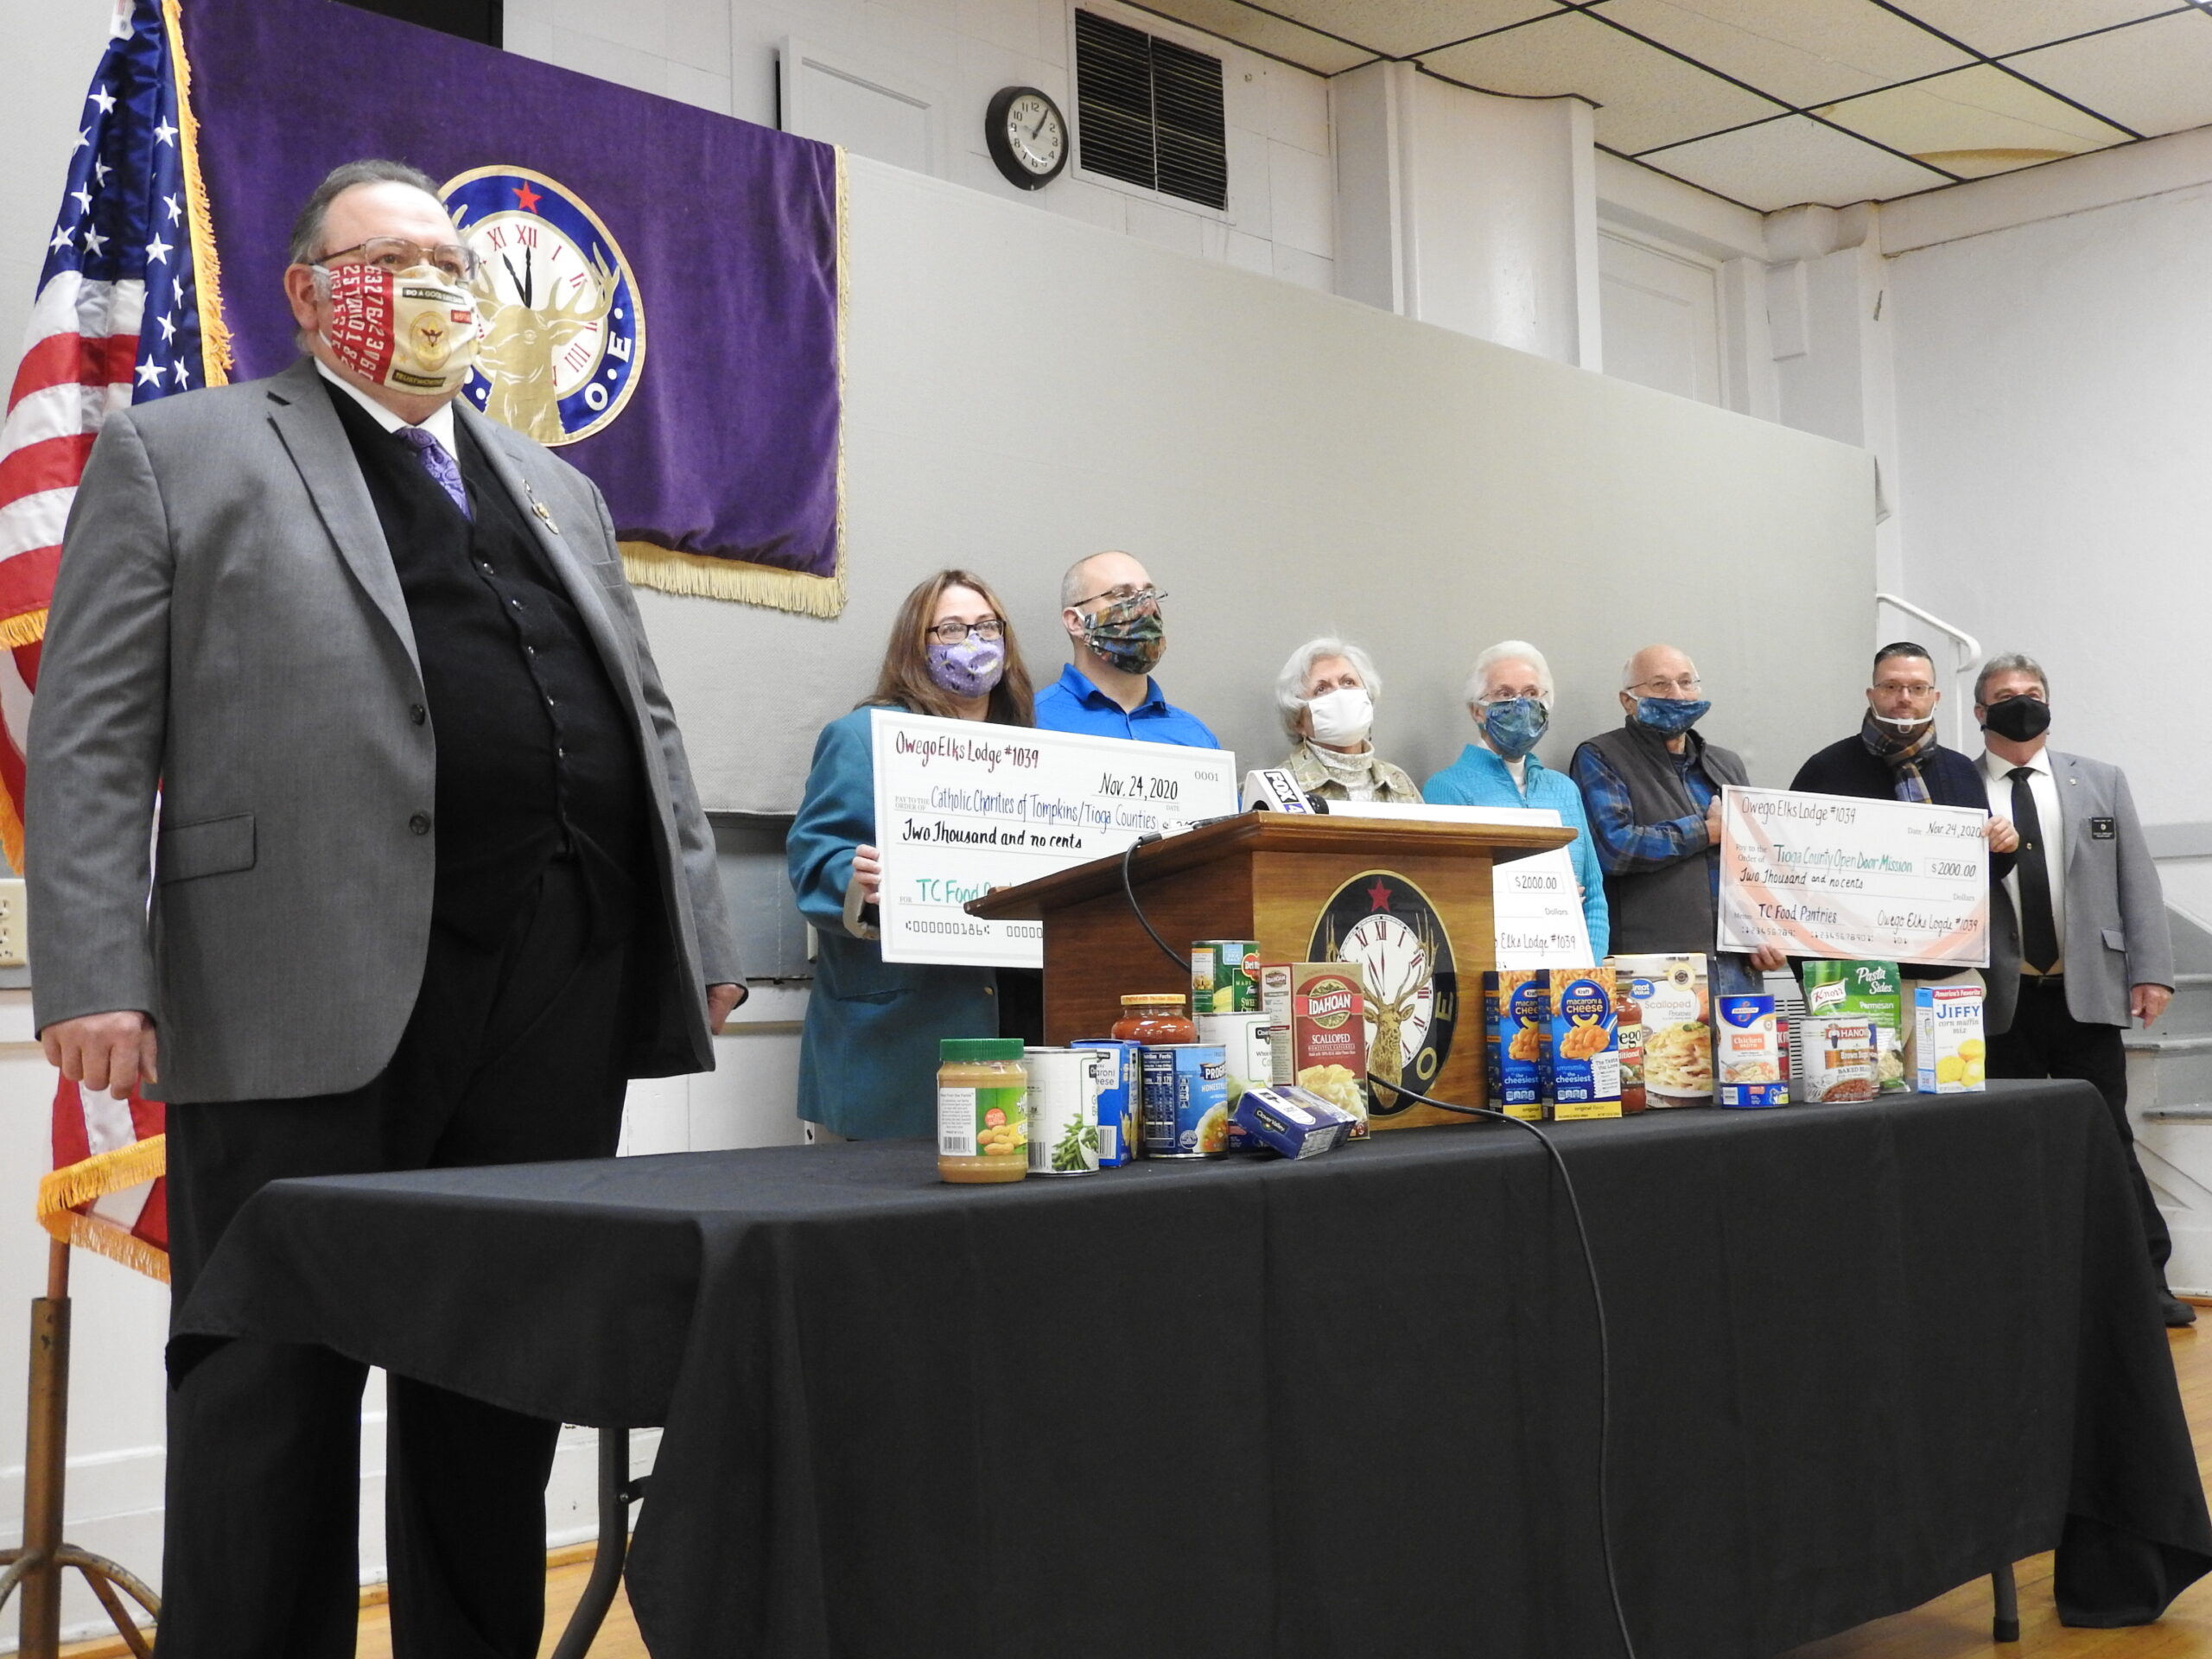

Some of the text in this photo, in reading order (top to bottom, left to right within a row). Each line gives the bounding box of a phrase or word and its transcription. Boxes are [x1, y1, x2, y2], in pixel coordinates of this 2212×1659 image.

[1022, 102, 1028, 112] 11
[1031, 102, 1039, 112] 12
[1014, 110, 1022, 122] 10
[1050, 123, 1055, 132] 2
[1014, 138, 1020, 148] 8
[1052, 137, 1058, 147] 3
[1048, 150, 1054, 159] 4
[486, 226, 507, 251] XI
[516, 224, 537, 248] XII
[551, 245, 562, 260] I
[896, 731, 1039, 773] Owego Elks Lodge #1039
[1194, 771, 1219, 781] 0001
[1099, 772, 1126, 797] Nov.
[1265, 772, 1300, 803] FOX
[931, 785, 972, 811] Catholic
[973, 789, 1014, 816] Charities
[1017, 793, 1027, 822] of
[1116, 804, 1156, 830] Counties
[1742, 796, 1856, 826] Owego Elks Lodge #1039
[902, 817, 1082, 849] Two Thousand and no cents
[1736, 843, 1746, 853] Pay
[1757, 844, 1767, 853] the
[1738, 854, 1766, 863] Order of
[1773, 844, 1913, 875] Tioga County Open Door Mission
[1739, 867, 1864, 889] Two Thousand and no cents
[916, 879, 941, 902] TC
[946, 880, 979, 904] Food
[1545, 907, 1568, 916] Dollars
[1758, 903, 1837, 924] TC Food Pantries
[1375, 920, 1387, 940] XII
[1878, 910, 1905, 935] Owego
[1906, 912, 1926, 928] Elks
[1955, 918, 1979, 932] #1039
[1355, 928, 1369, 950] XI
[1397, 931, 1406, 948] I
[1501, 932, 1576, 957] Elks Lodge #1039
[1856, 966, 1886, 985] Pasta
[1631, 982, 1649, 992] reat
[1869, 981, 1893, 995] Sides
[1241, 997, 1257, 1007] SWEE
[1815, 988, 1844, 1002] Knorr
[1308, 994, 1351, 1015] IDAHOAN
[1644, 1000, 1691, 1009] Scalloped
[1859, 1001, 1894, 1009] Parmesan
[1936, 1004, 1980, 1019] JIFFY
[1312, 1033, 1351, 1044] SCALLOPED
[1619, 1030, 1641, 1049] ego
[1733, 1036, 1763, 1045] Chicken
[1618, 1049, 1641, 1060] ditional
[1096, 1068, 1116, 1077] aroni
[1205, 1063, 1226, 1079] PROG
[1504, 1076, 1539, 1084] cheesiest
[1555, 1074, 1592, 1084] cheesiest
[1256, 1109, 1285, 1132] Clover Valley
